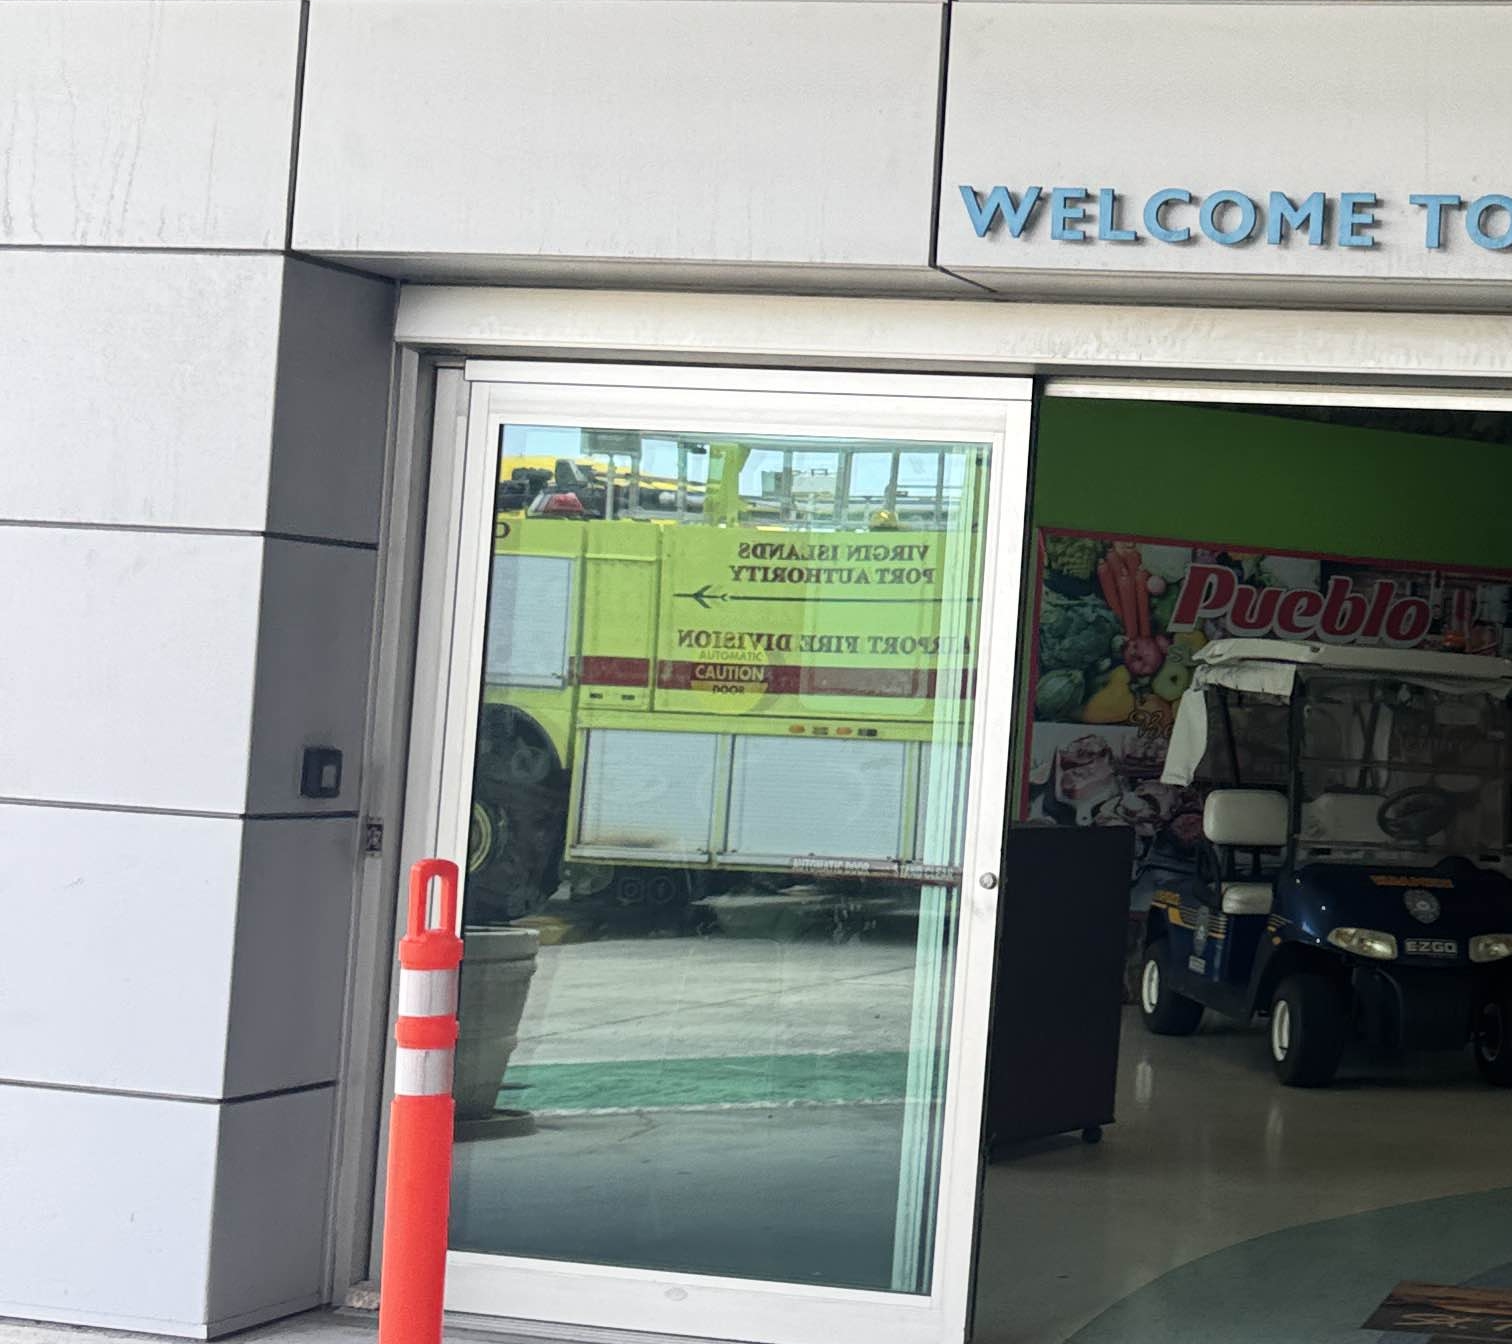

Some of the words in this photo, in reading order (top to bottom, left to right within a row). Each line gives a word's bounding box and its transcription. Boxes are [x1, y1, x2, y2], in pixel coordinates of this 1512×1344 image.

[958, 184, 1377, 248] WELCOME
[1169, 563, 1434, 645] Pueblo
[700, 650, 763, 661] AUTOMATIC
[695, 664, 764, 681] CAUTION
[712, 684, 745, 695] DOOR
[1407, 940, 1458, 953] EZGO
